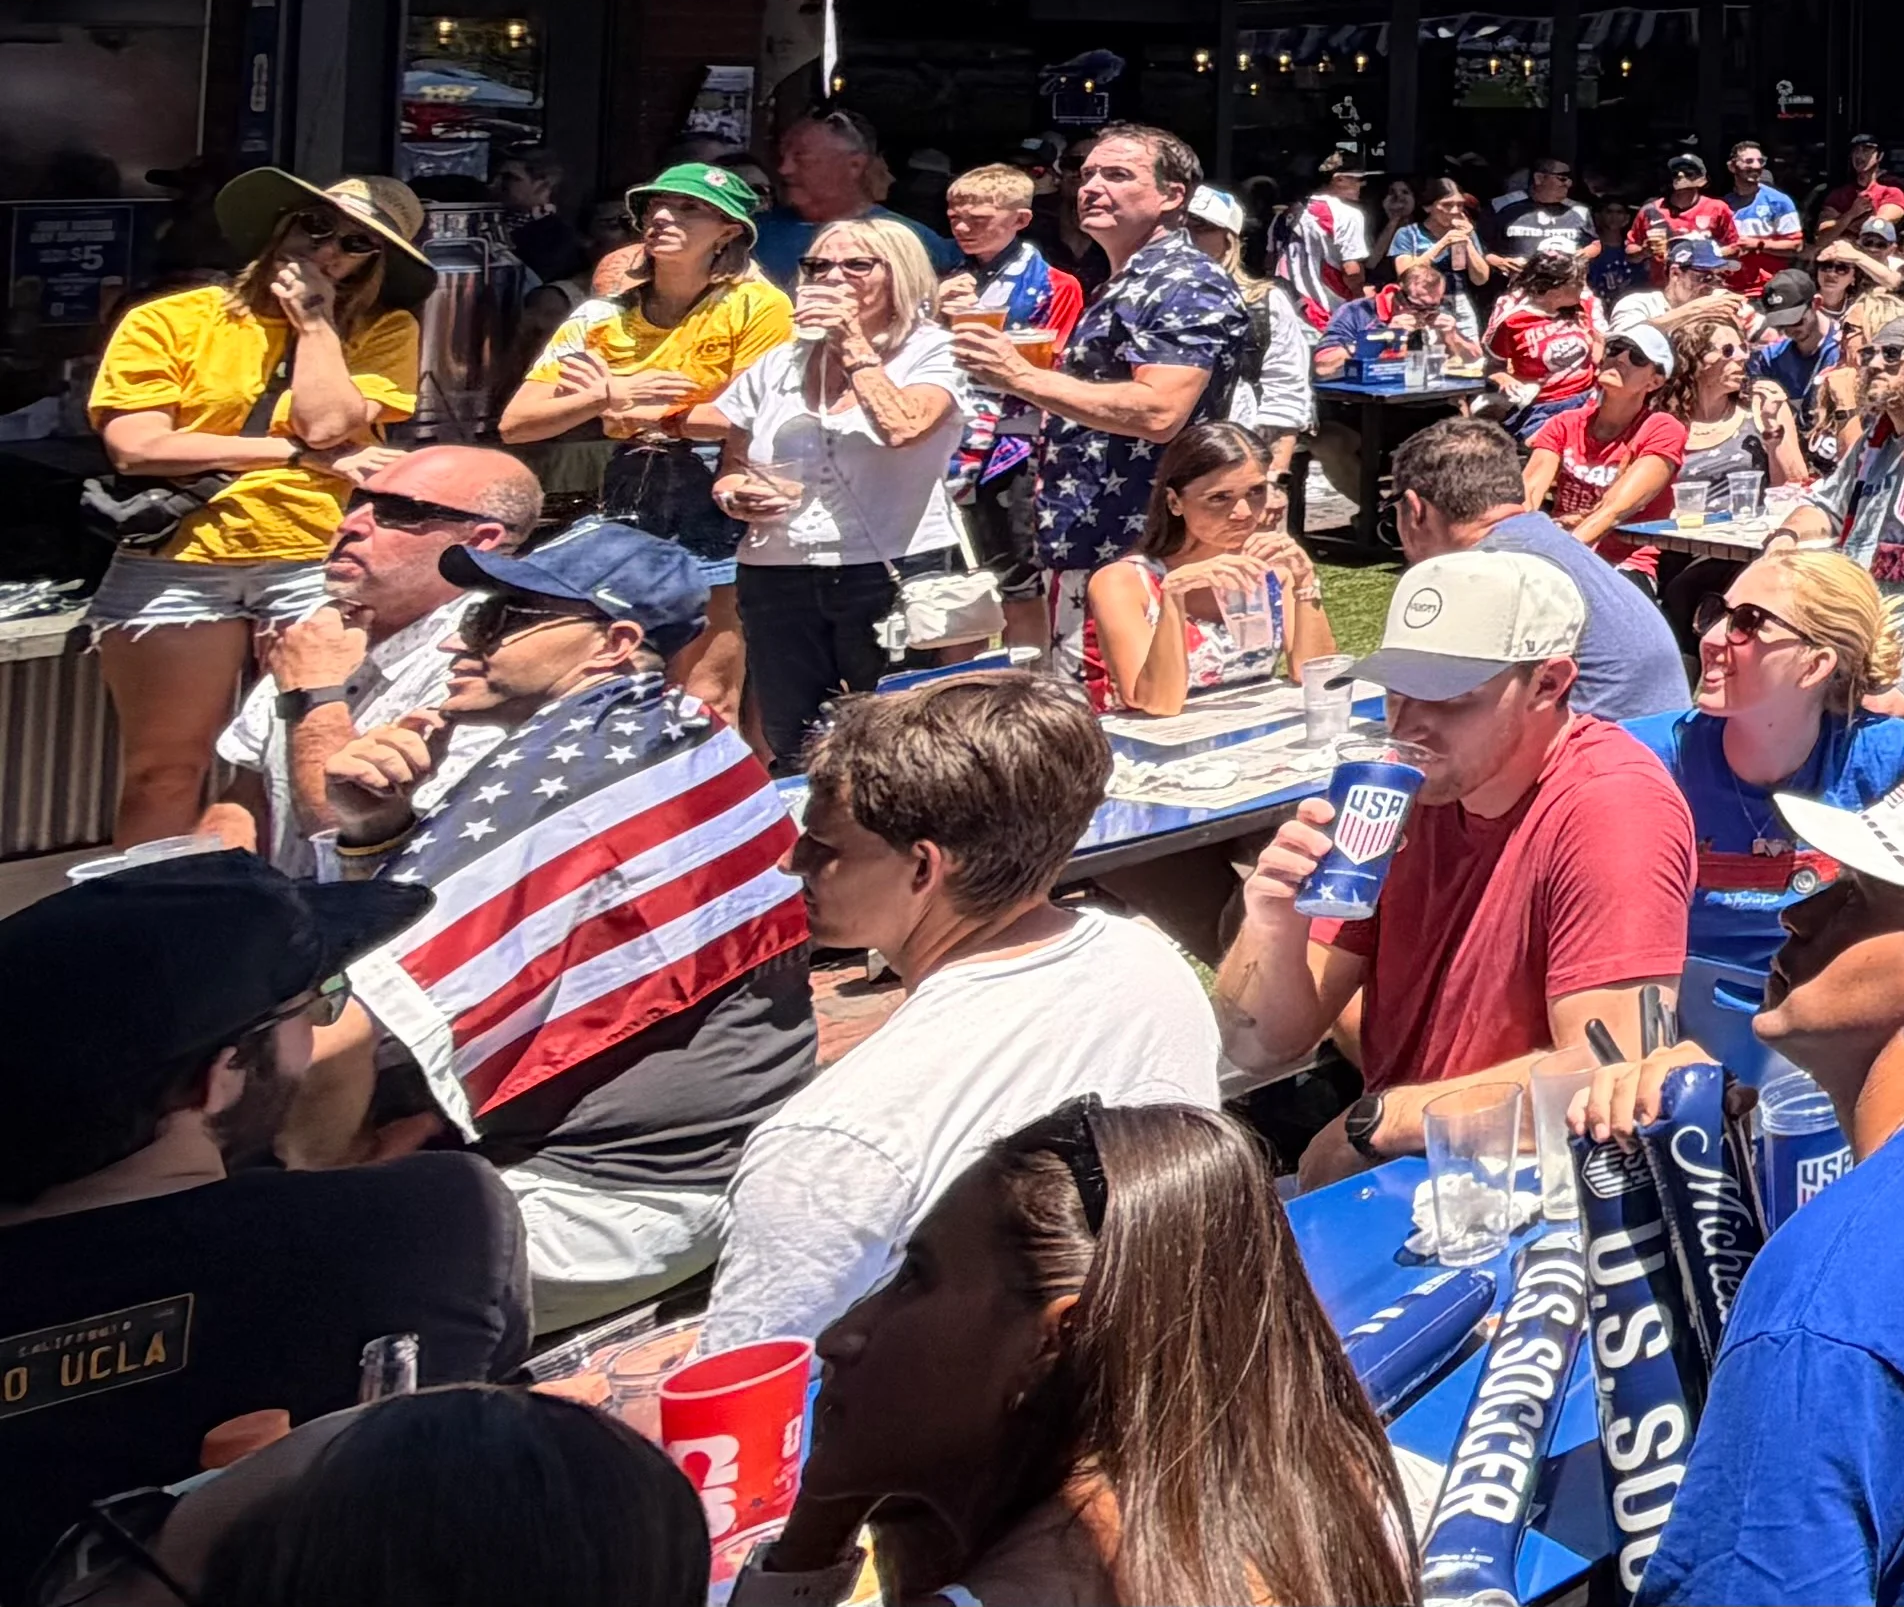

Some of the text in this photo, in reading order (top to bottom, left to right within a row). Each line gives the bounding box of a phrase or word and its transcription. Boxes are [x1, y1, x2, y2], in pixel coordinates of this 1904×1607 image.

[1350, 788, 1405, 821] USA
[60, 1330, 167, 1388] UCLA
[1432, 1337, 1565, 1535] SOCCER
